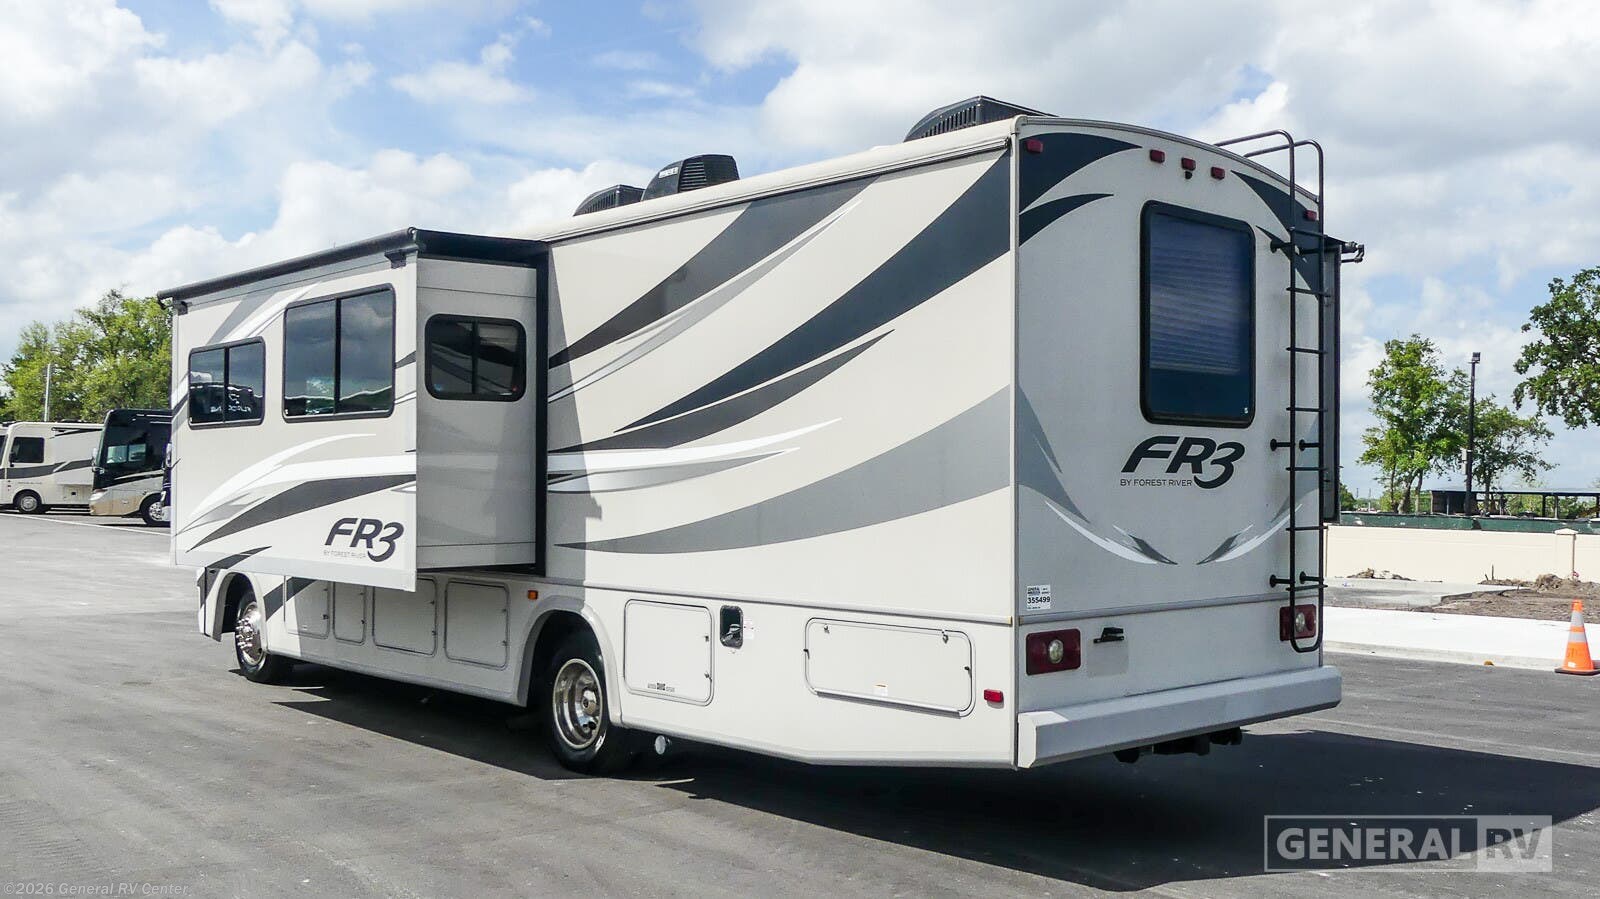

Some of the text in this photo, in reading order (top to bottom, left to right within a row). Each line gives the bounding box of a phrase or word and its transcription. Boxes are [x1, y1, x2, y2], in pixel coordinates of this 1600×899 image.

[1121, 436, 1245, 489] FR3
[1169, 479, 1192, 487] RIVER
[324, 517, 404, 562] FR3
[1027, 596, 1050, 604] 355499
